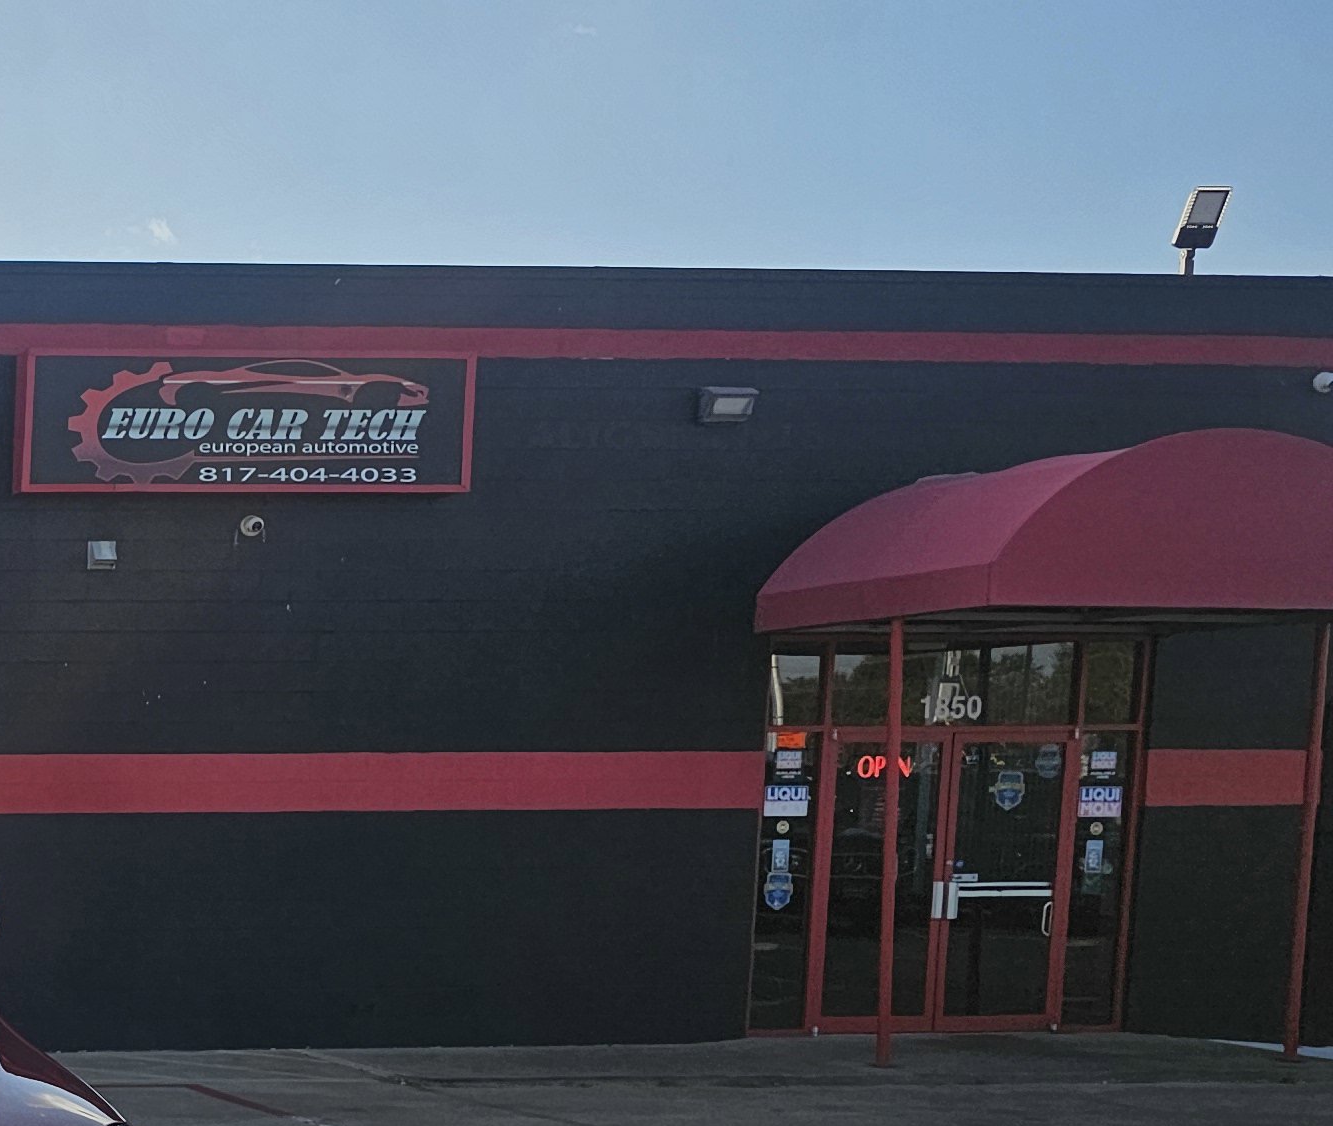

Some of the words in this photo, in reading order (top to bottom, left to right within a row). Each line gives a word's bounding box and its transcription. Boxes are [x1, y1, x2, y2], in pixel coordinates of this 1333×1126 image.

[101, 408, 215, 440] EURO
[226, 408, 309, 441] CAR
[322, 408, 429, 441] TECH
[199, 443, 297, 456] european
[302, 441, 419, 455] automotive
[198, 466, 417, 483] 817-404-4033
[920, 695, 983, 720] 1850
[857, 755, 912, 779] OPN
[767, 787, 808, 801] LIQUI
[1083, 788, 1121, 801] LIQUI
[1081, 802, 1121, 816] MOLY
